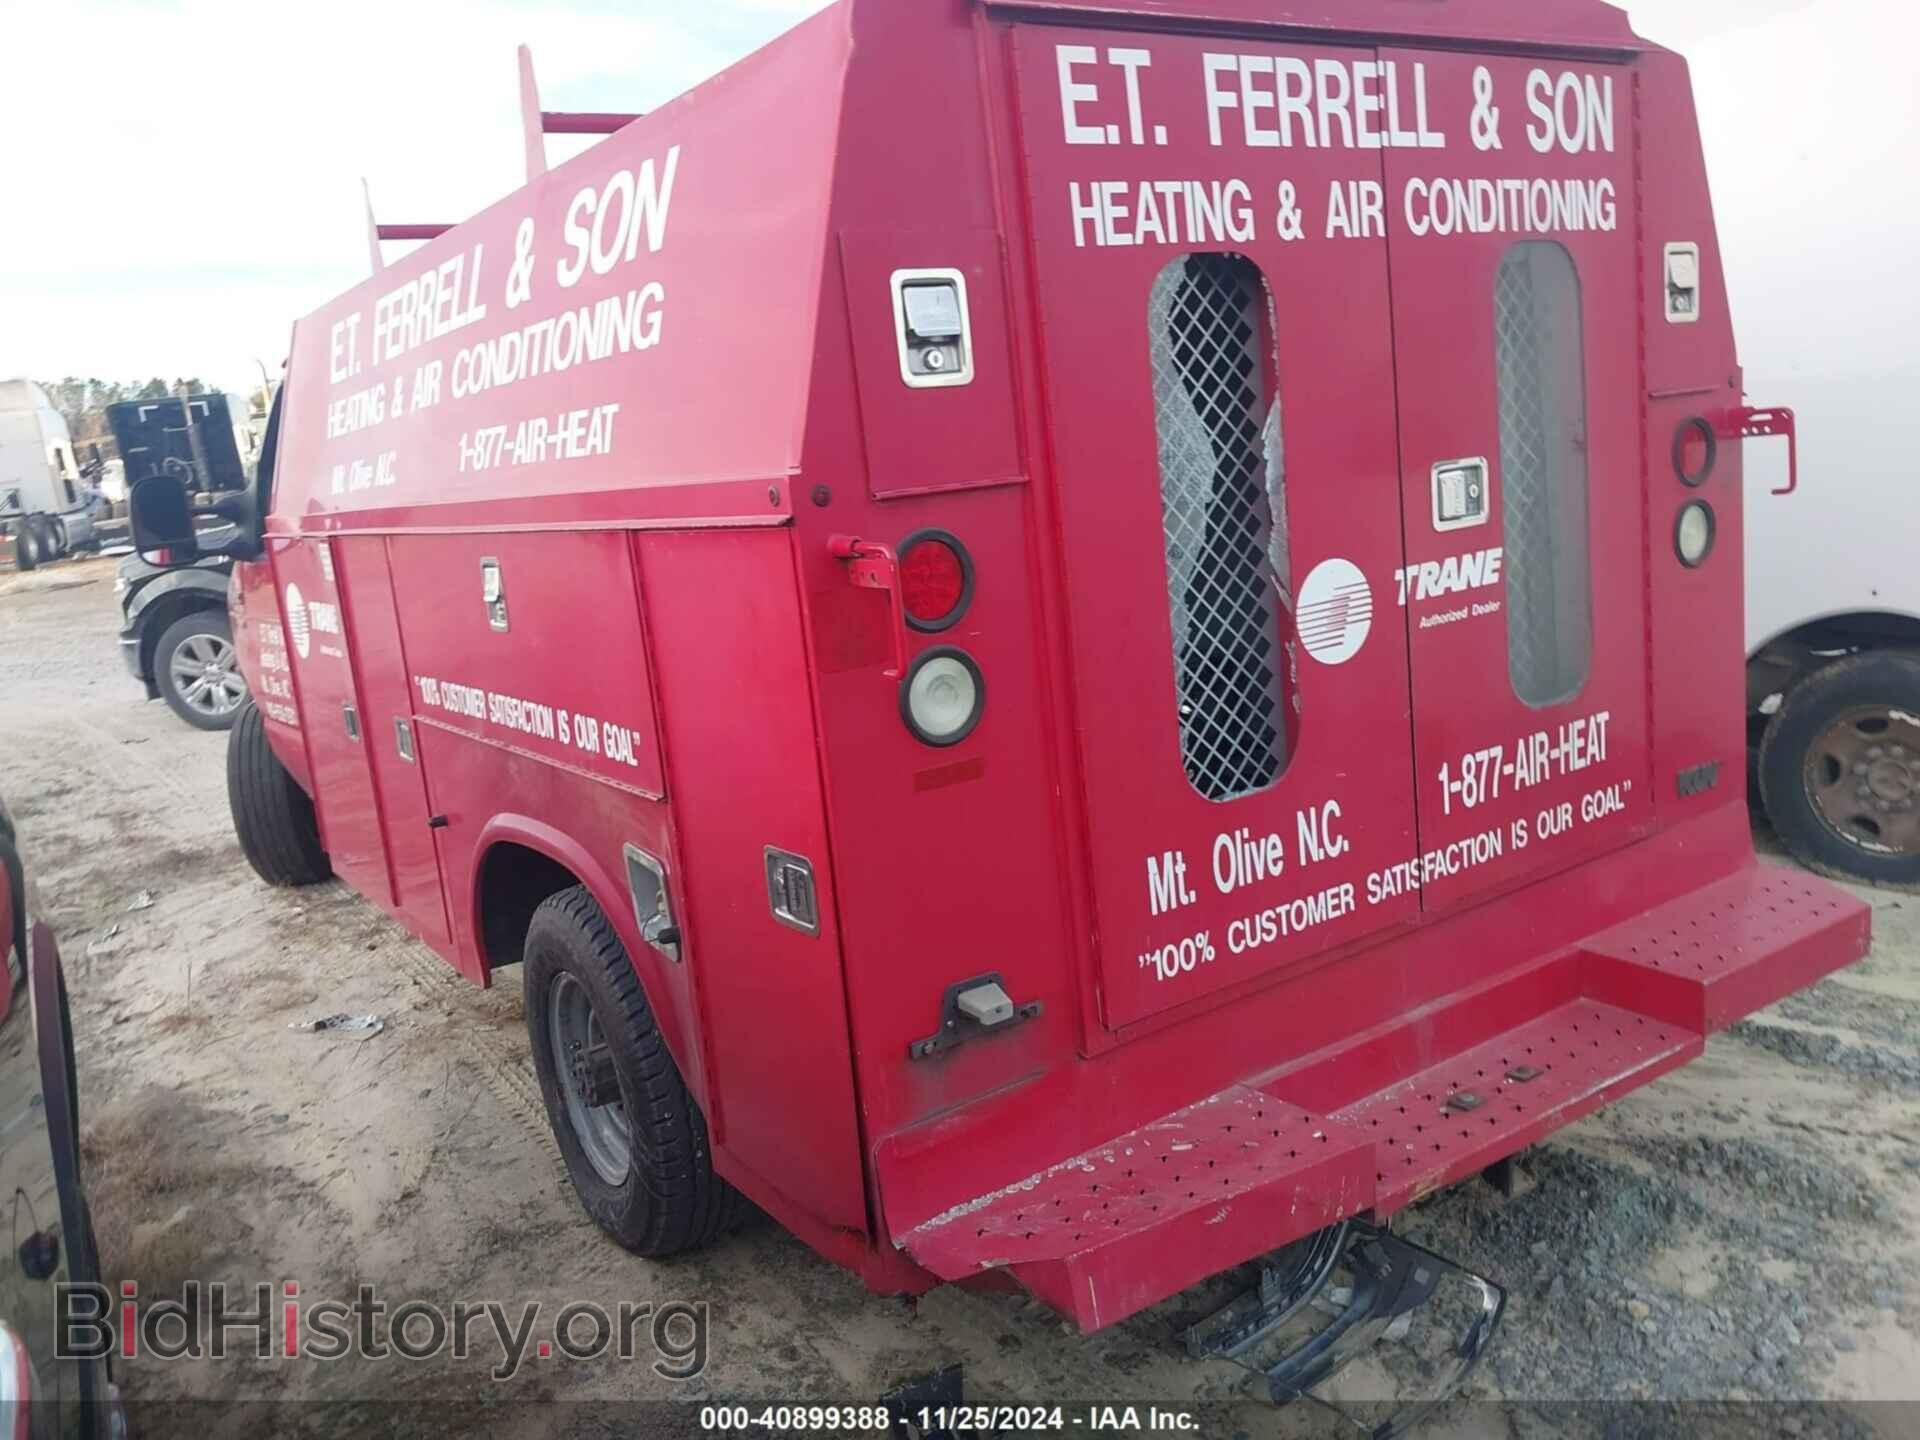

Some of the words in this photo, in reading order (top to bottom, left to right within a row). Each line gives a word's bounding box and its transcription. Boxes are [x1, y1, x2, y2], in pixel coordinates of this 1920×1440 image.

[1054, 44, 1168, 146] E.T.
[1202, 52, 1446, 149] FERRELL
[1470, 65, 1503, 151] &
[1525, 68, 1615, 154] SON
[372, 242, 487, 367] FERRELL
[505, 217, 535, 309] &
[556, 144, 681, 288] SON
[1068, 177, 1256, 248] HEATING
[1276, 179, 1305, 241] &
[1325, 179, 1387, 239] AIR
[1403, 177, 1617, 236] CONDITIONING
[327, 382, 386, 440] HEATING
[390, 375, 403, 419] &
[410, 359, 443, 416] AIR
[451, 280, 666, 400] CONDITIONING
[458, 403, 620, 473] 1-877-AIR-HEAT
[1394, 546, 1504, 607] TRANE
[1419, 606, 1469, 629] Authorized
[1471, 600, 1502, 618] Dealer
[441, 680, 487, 721] CUSTOMER
[488, 691, 554, 740] SATISFACTION
[557, 709, 571, 745] IS
[574, 713, 600, 753] OUR
[1437, 711, 1611, 816] 1-877-AIR-HEAT
[1146, 850, 1197, 916] Mt.
[1212, 828, 1284, 895] Olive
[1296, 799, 1350, 867] N.C.
[1227, 882, 1355, 955] CUSTOMER
[1366, 828, 1503, 906] SATISFACTION
[1510, 819, 1530, 850] IS
[1536, 802, 1573, 841] OUR
